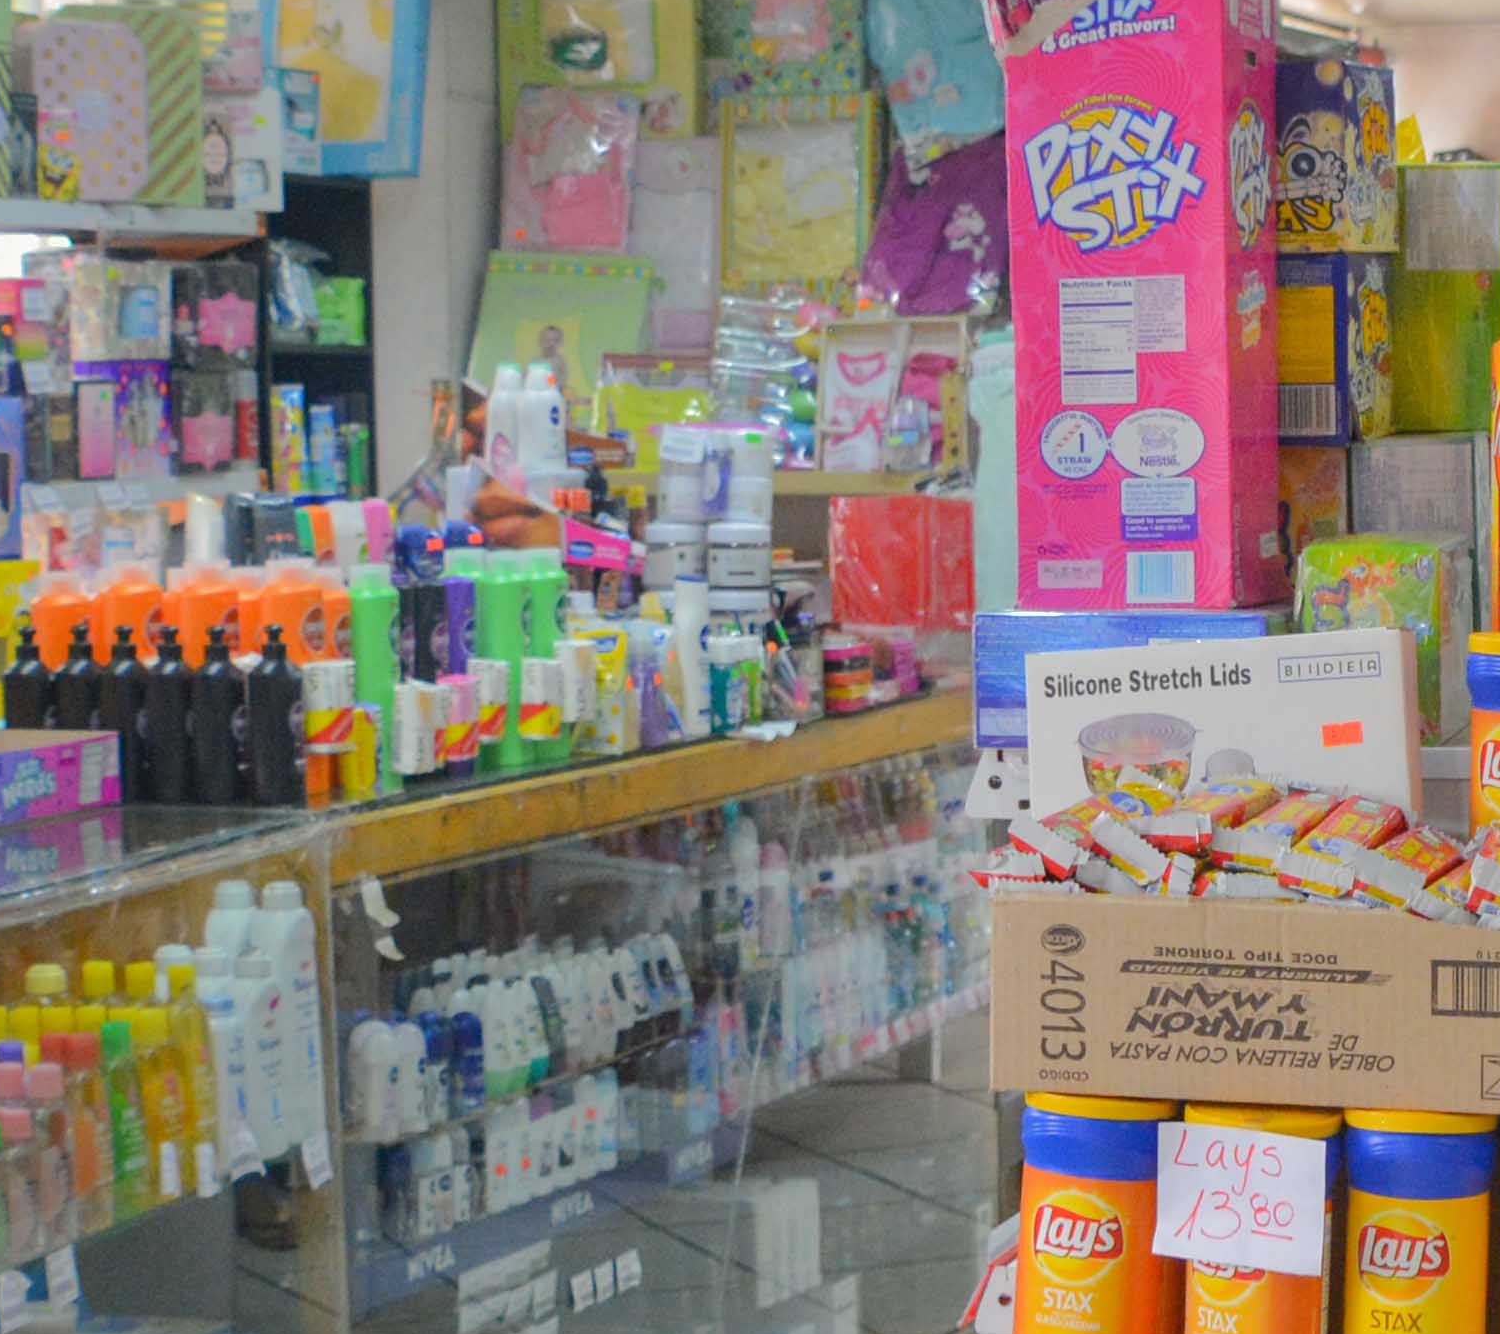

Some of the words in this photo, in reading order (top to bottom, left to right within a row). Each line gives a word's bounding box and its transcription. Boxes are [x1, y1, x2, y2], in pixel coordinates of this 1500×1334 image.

[1042, 37, 1057, 54] 4
[1058, 26, 1105, 50] Great
[1109, 15, 1176, 38] Flavors!
[1043, 669, 1123, 699] Silicone
[1128, 665, 1203, 693] Stretch
[1209, 664, 1252, 688] Lids
[1153, 945, 1235, 960] TORRONE
[1241, 948, 1284, 963] TIPO
[1290, 951, 1338, 965] DOCE
[1039, 960, 1086, 1061] 4013
[1109, 1040, 1173, 1062] PASTA
[1328, 1032, 1359, 1051] DE
[1178, 1045, 1229, 1064] CON
[1234, 1047, 1323, 1068] RELLENA
[1327, 1052, 1396, 1072] OBLEA
[1173, 1128, 1283, 1196] Lays
[1035, 1206, 1121, 1259] Lay's
[1360, 1226, 1446, 1278] Lay's
[1042, 1287, 1094, 1314] STAX
[1197, 1306, 1239, 1334] STAX
[1370, 1309, 1423, 1333] STAX
